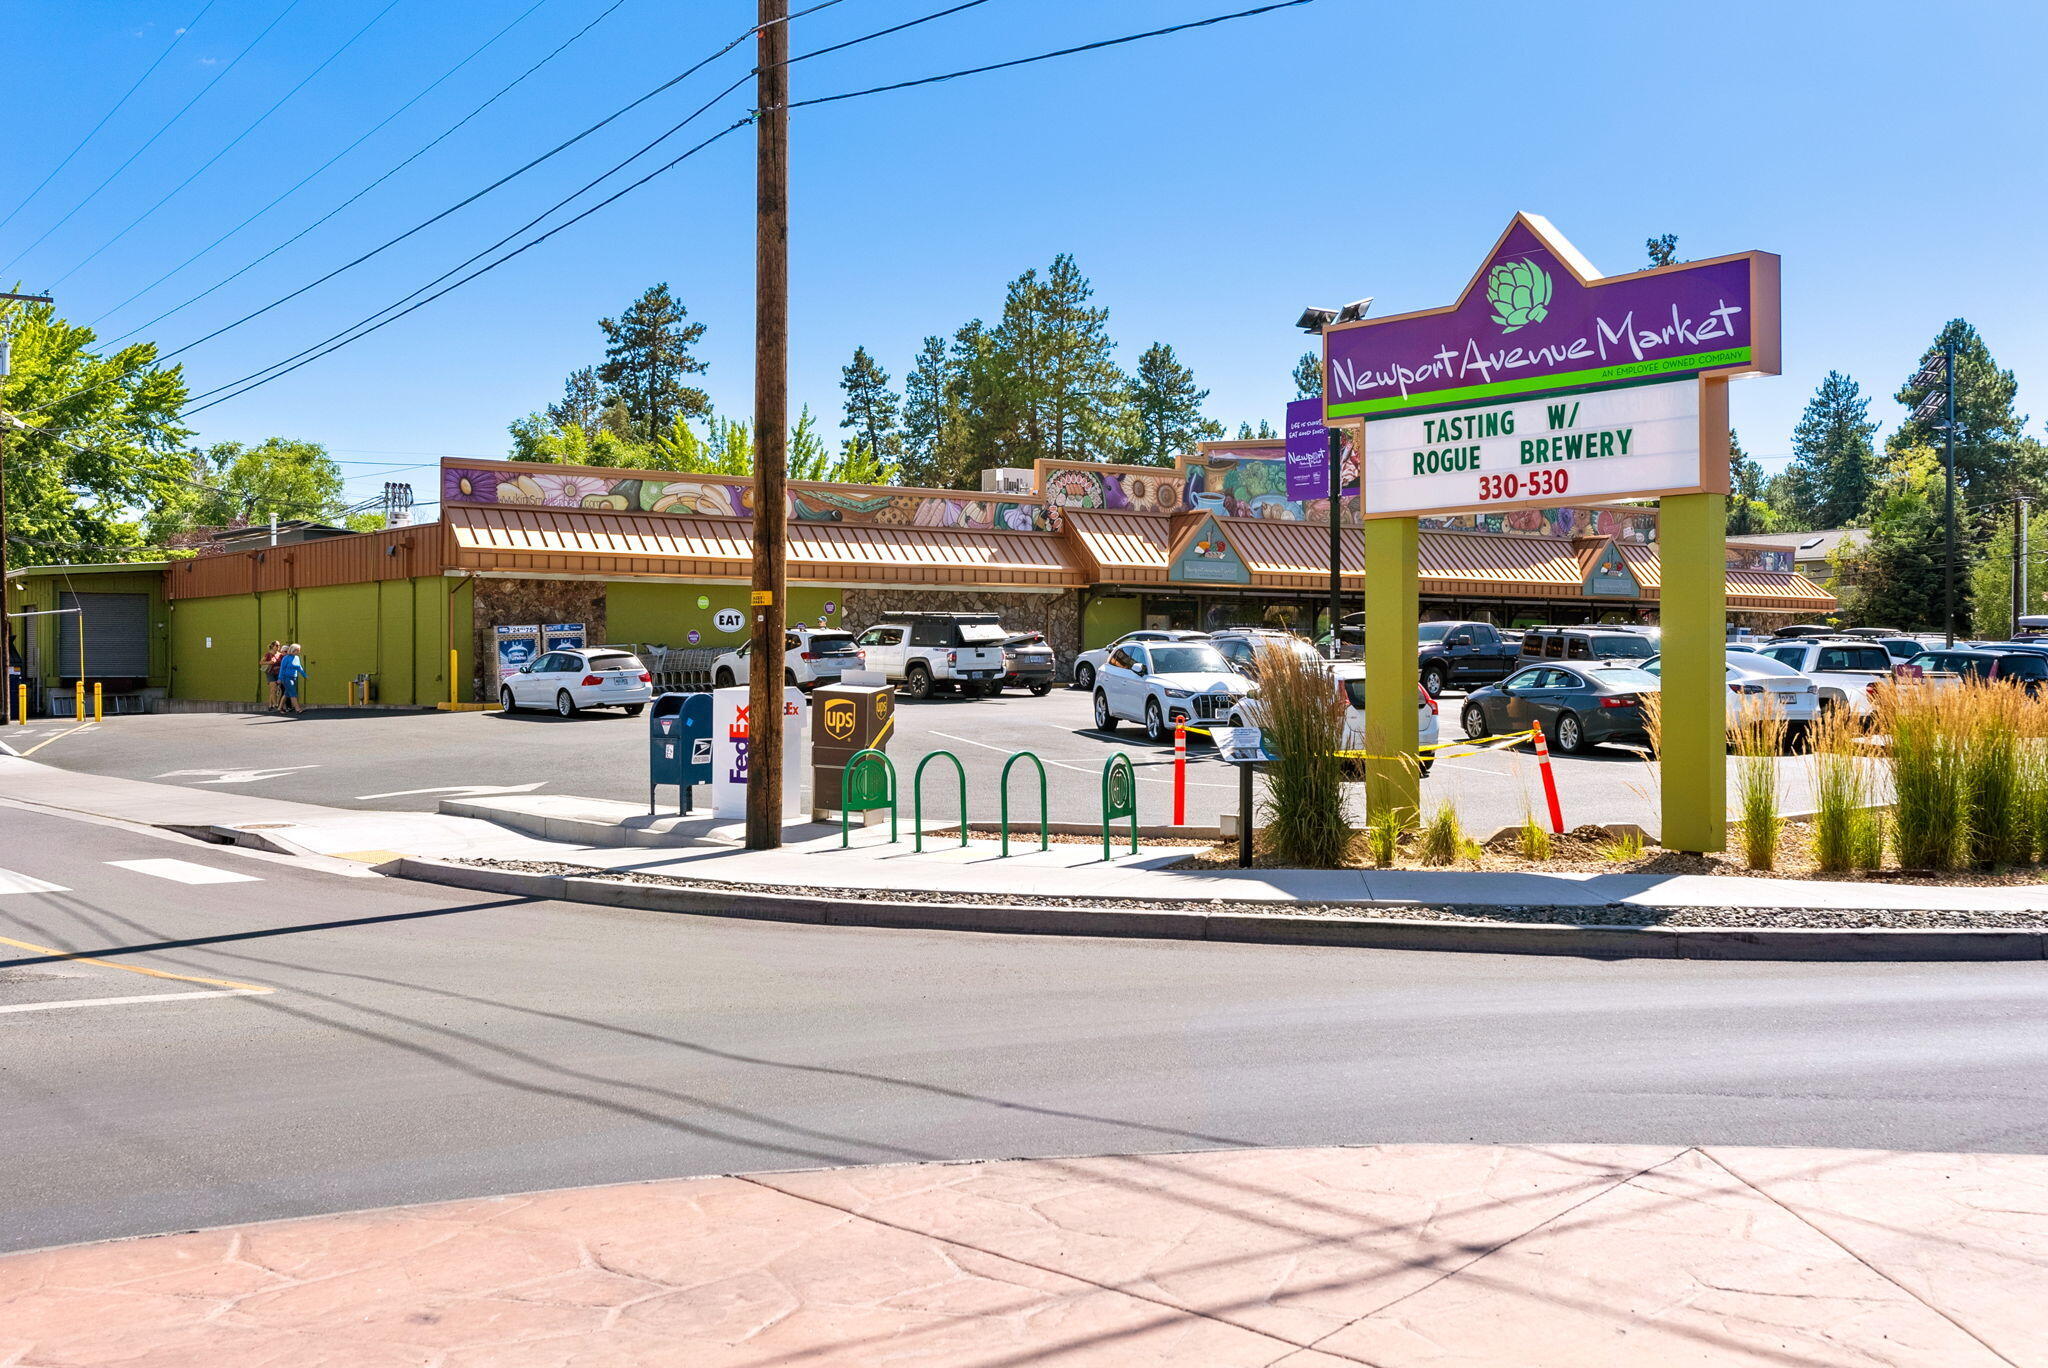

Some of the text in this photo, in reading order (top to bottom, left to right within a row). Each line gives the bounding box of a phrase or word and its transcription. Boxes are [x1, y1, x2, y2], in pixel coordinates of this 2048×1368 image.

[1331, 298, 1742, 400] Newport Avenue Market
[1602, 351, 1743, 378] AN EMPLOYEE OWNED COMPANY
[1423, 402, 1580, 445] TASTING W/
[1412, 428, 1633, 476] ROGUE BREWERY
[1478, 468, 1569, 501] 330-530
[718, 614, 741, 626] EAT
[826, 711, 854, 733] ups
[729, 705, 750, 784] FedEx
